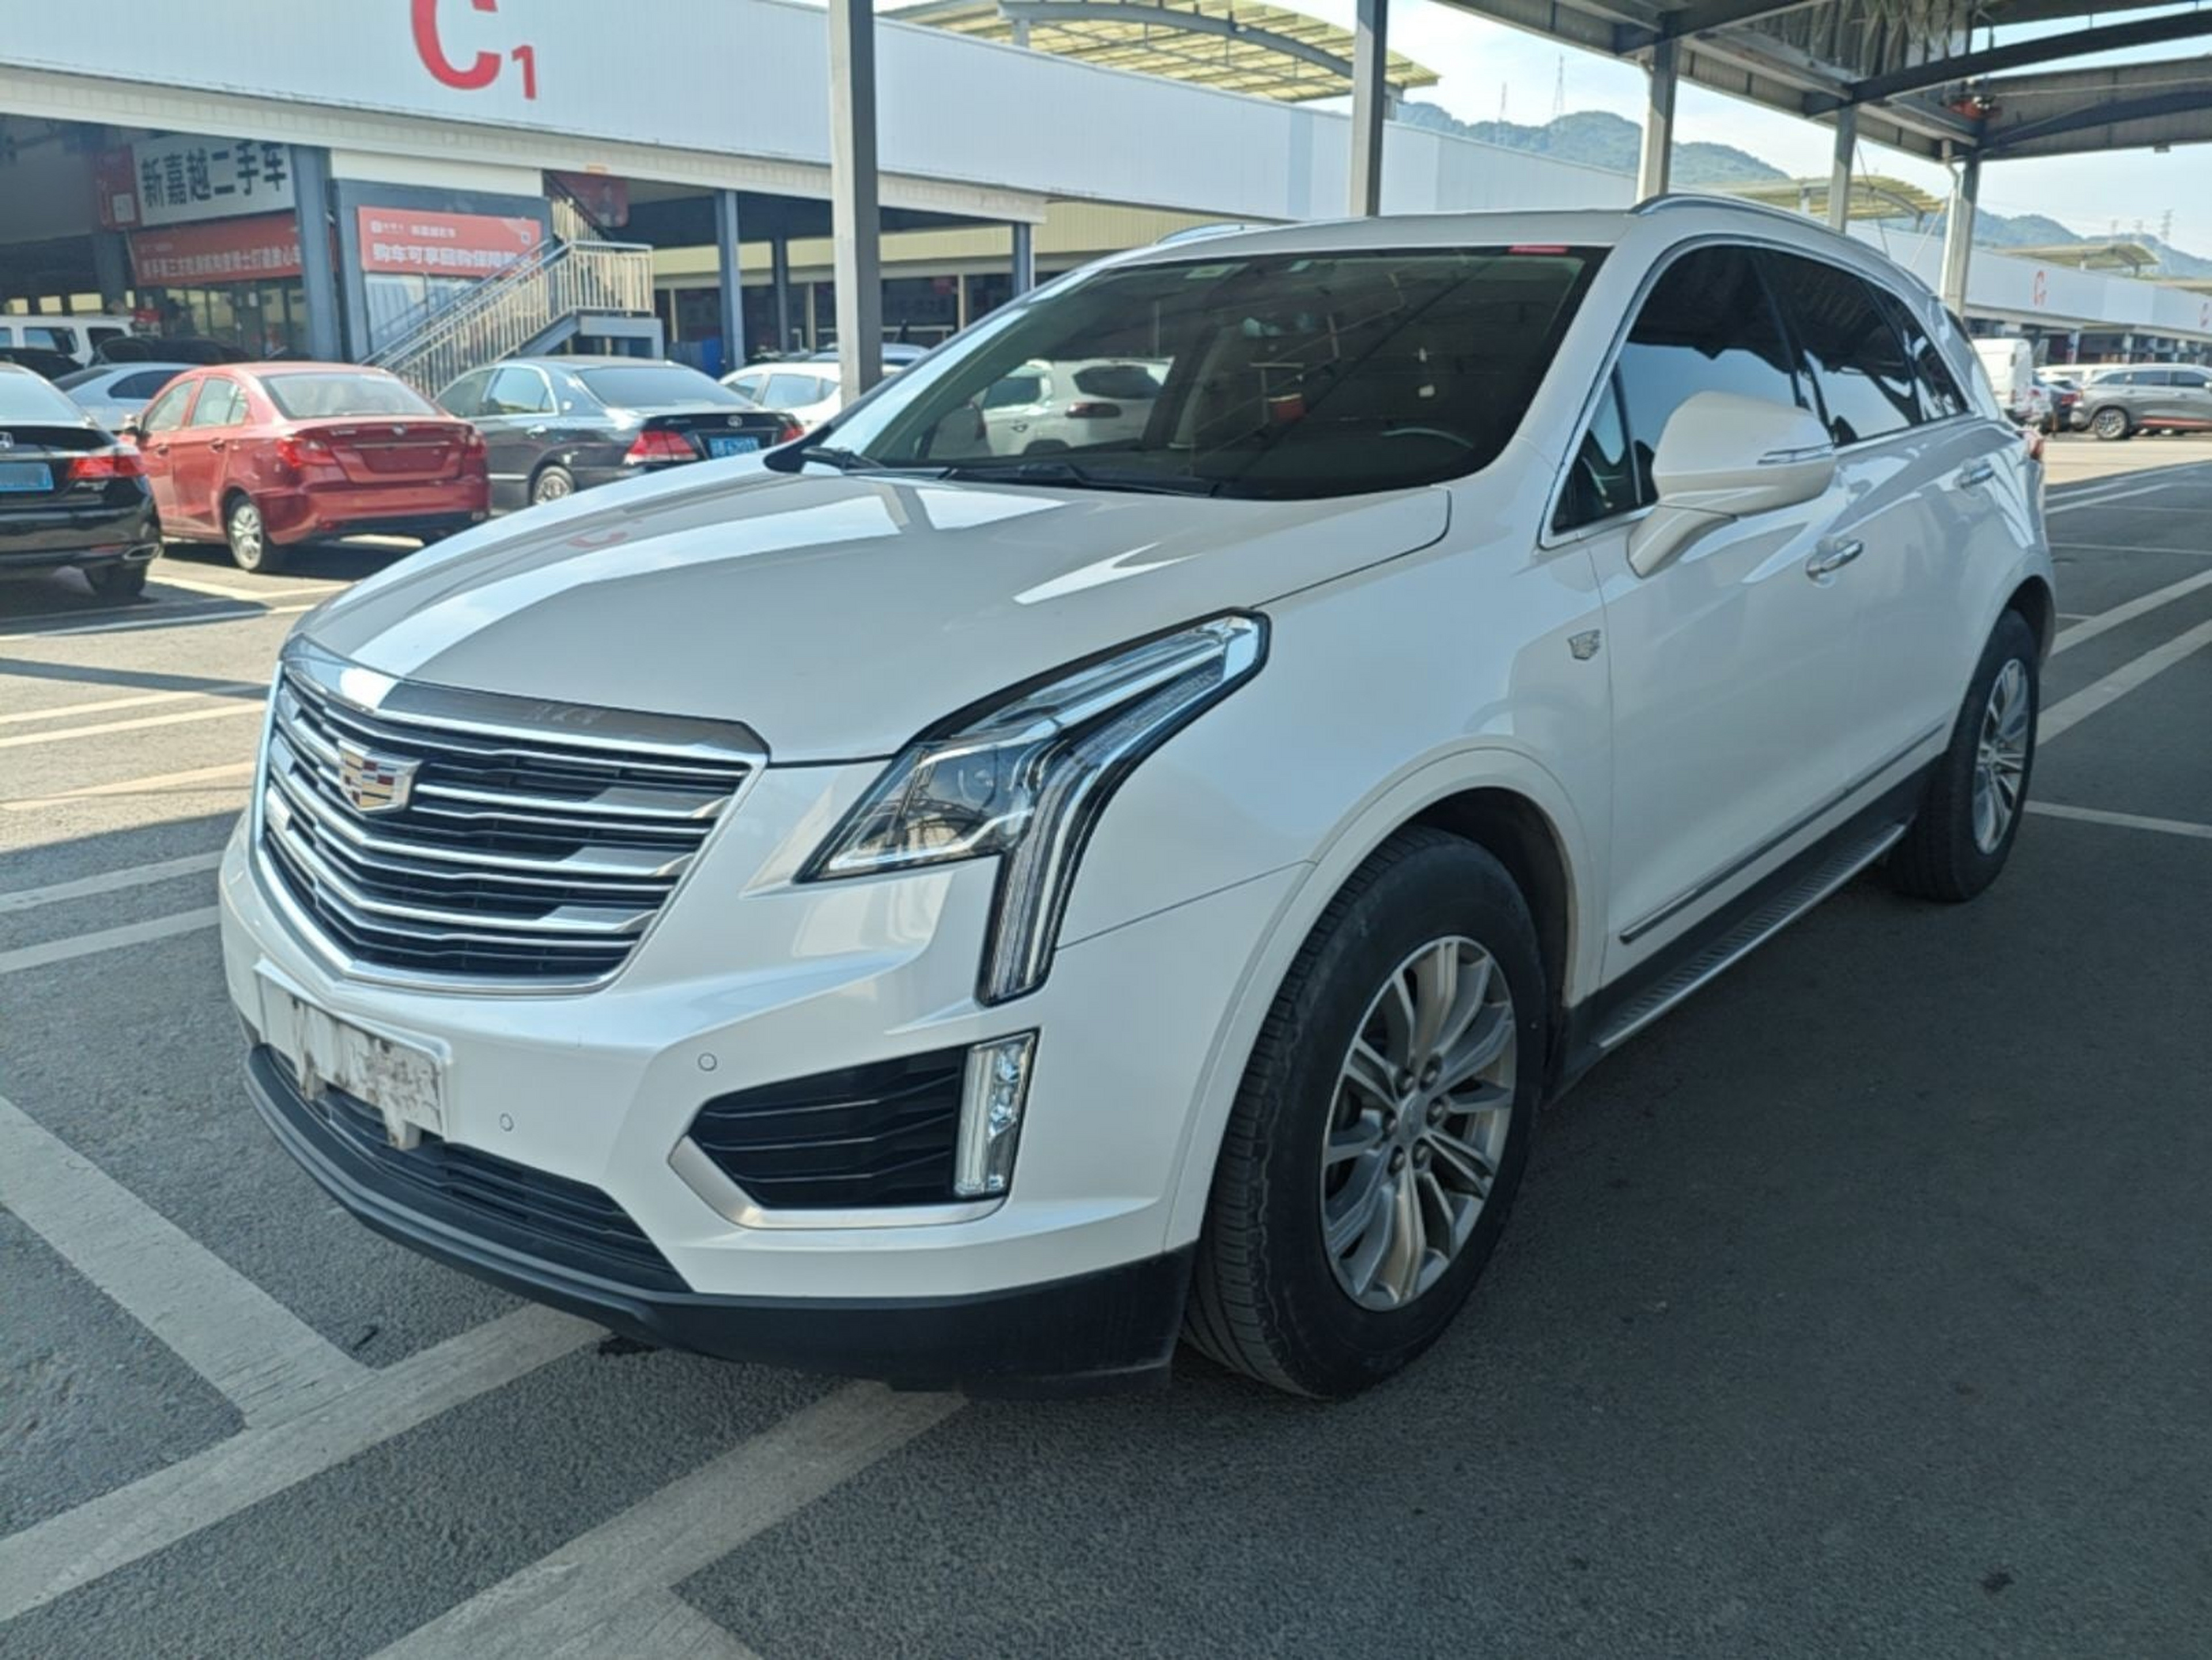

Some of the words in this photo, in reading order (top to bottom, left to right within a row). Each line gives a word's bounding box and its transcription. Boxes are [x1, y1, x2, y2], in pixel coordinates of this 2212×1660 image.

[141, 139, 286, 207] 新嘉越二手车
